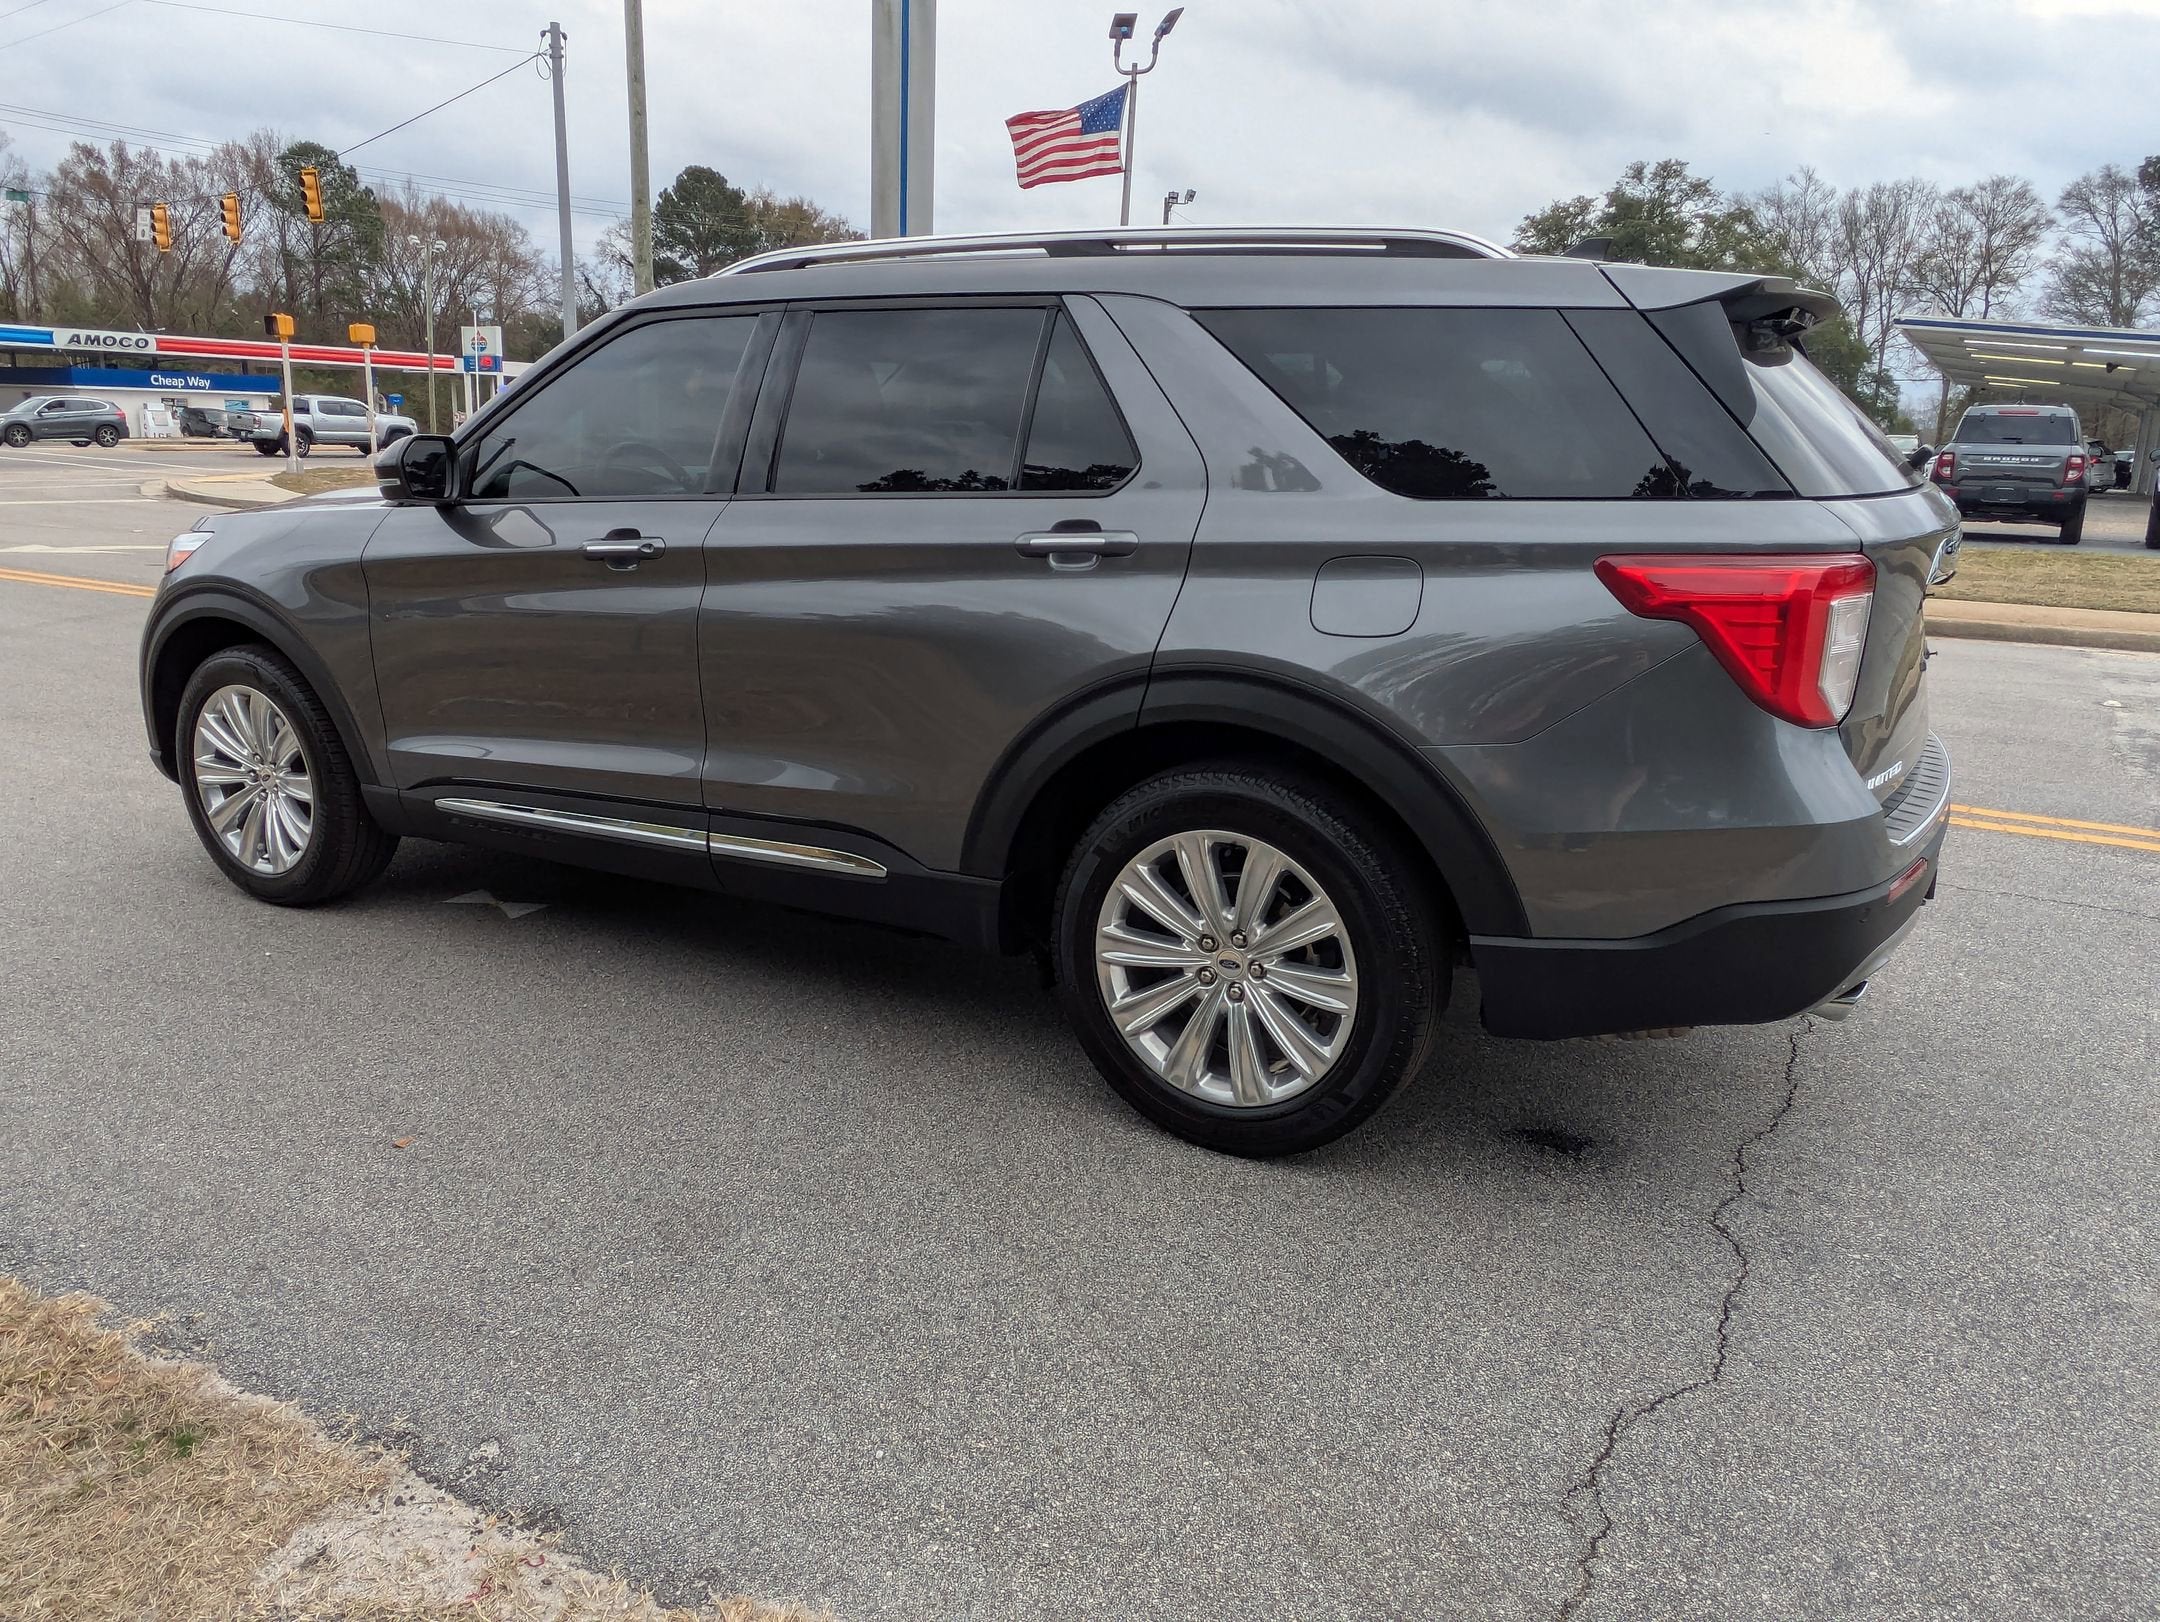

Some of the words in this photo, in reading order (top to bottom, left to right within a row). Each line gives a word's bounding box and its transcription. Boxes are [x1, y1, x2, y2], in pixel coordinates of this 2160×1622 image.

[67, 333, 149, 348] AMOCO
[150, 375, 185, 388] Cheap
[187, 376, 211, 389] Way
